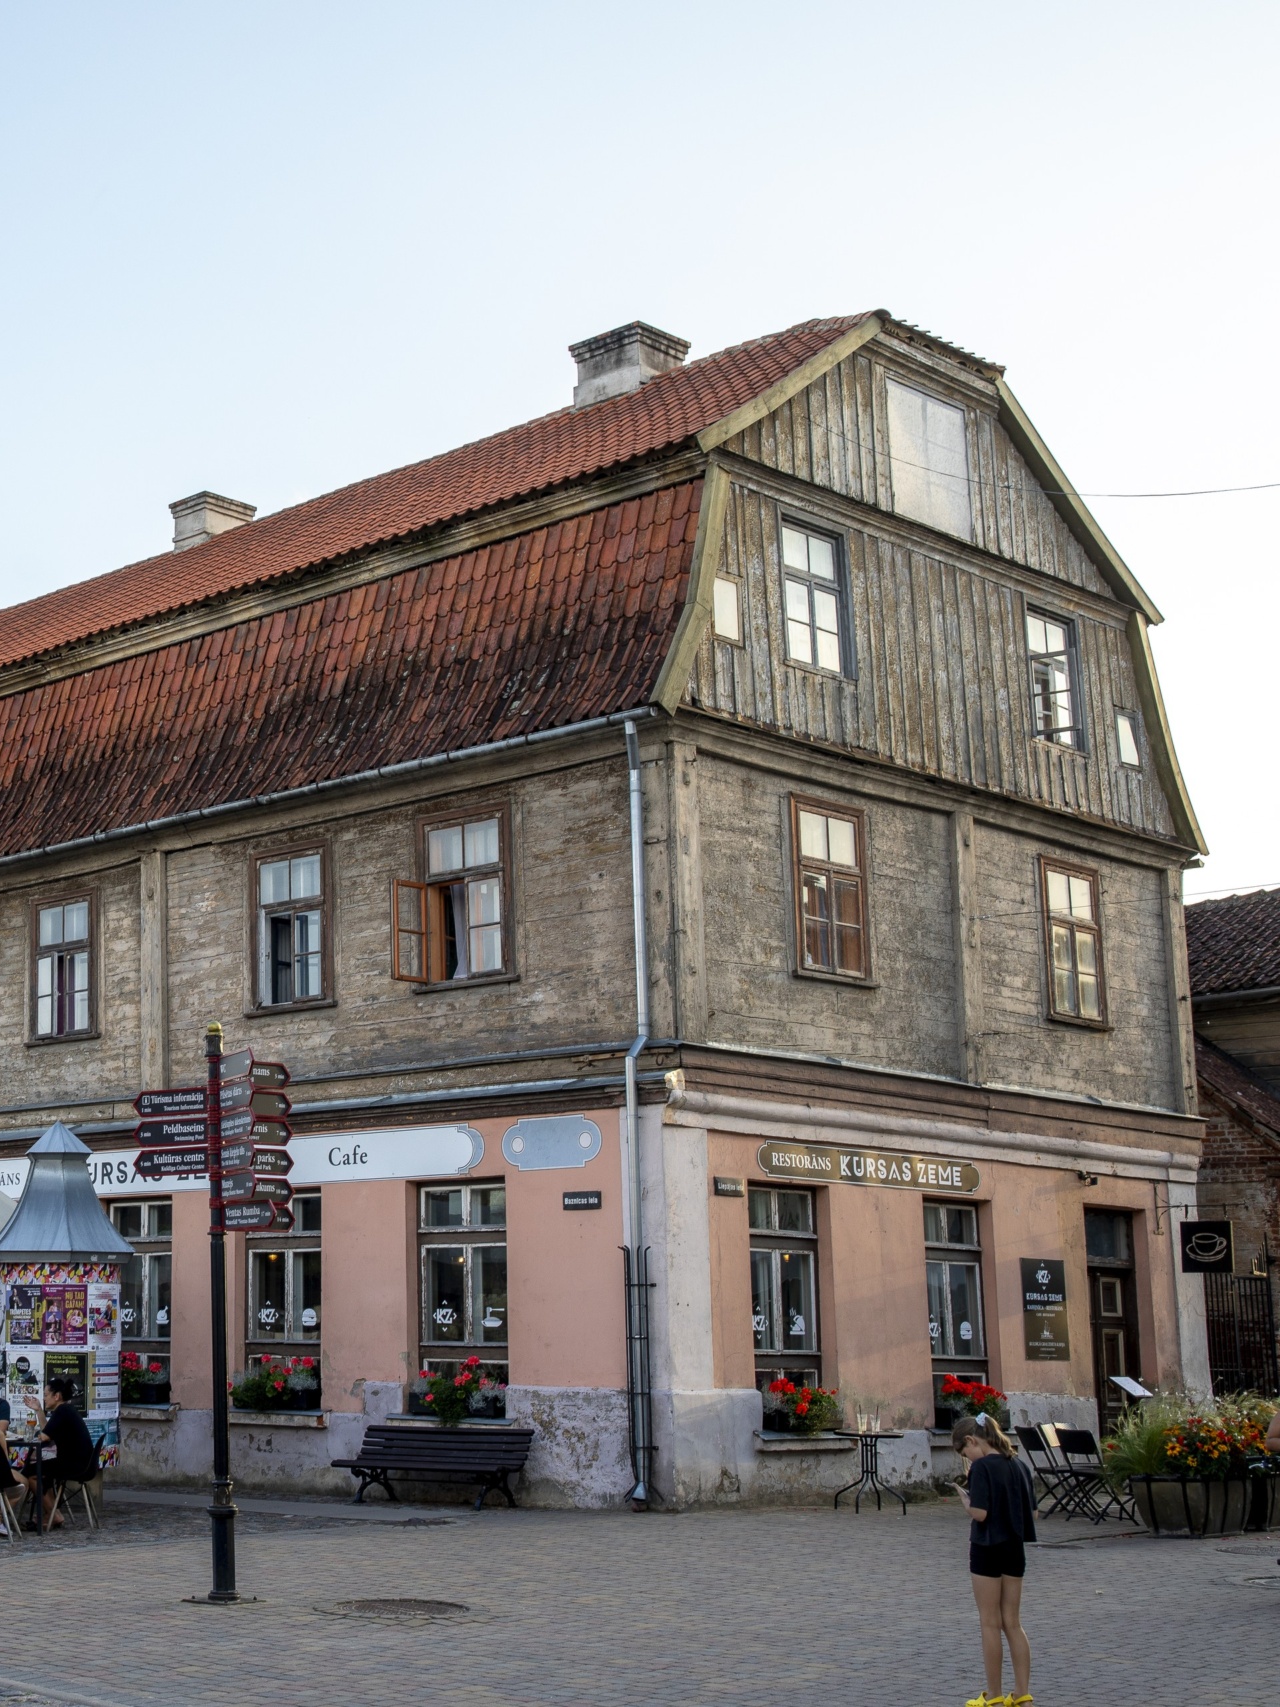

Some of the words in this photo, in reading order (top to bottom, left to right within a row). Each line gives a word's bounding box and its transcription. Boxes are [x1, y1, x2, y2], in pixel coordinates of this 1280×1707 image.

[151, 1094, 172, 1104] Tūrisma
[173, 1092, 204, 1103] informācija
[163, 1123, 204, 1134] Peldbaseins
[154, 1154, 182, 1164] Kultūras
[184, 1153, 205, 1162] centrs
[257, 1153, 275, 1164] parks
[328, 1144, 368, 1166] Cafe
[772, 1152, 832, 1171] RESTORĀNS
[840, 1155, 912, 1181] KURSAS
[917, 1162, 962, 1187] ZEME
[256, 1182, 275, 1192] ukums
[226, 1207, 241, 1218] Ventas
[243, 1206, 260, 1216] Rumba
[1026, 1292, 1048, 1301] KURSAS
[261, 1309, 275, 1322] KZ
[437, 1309, 452, 1323] KZ
